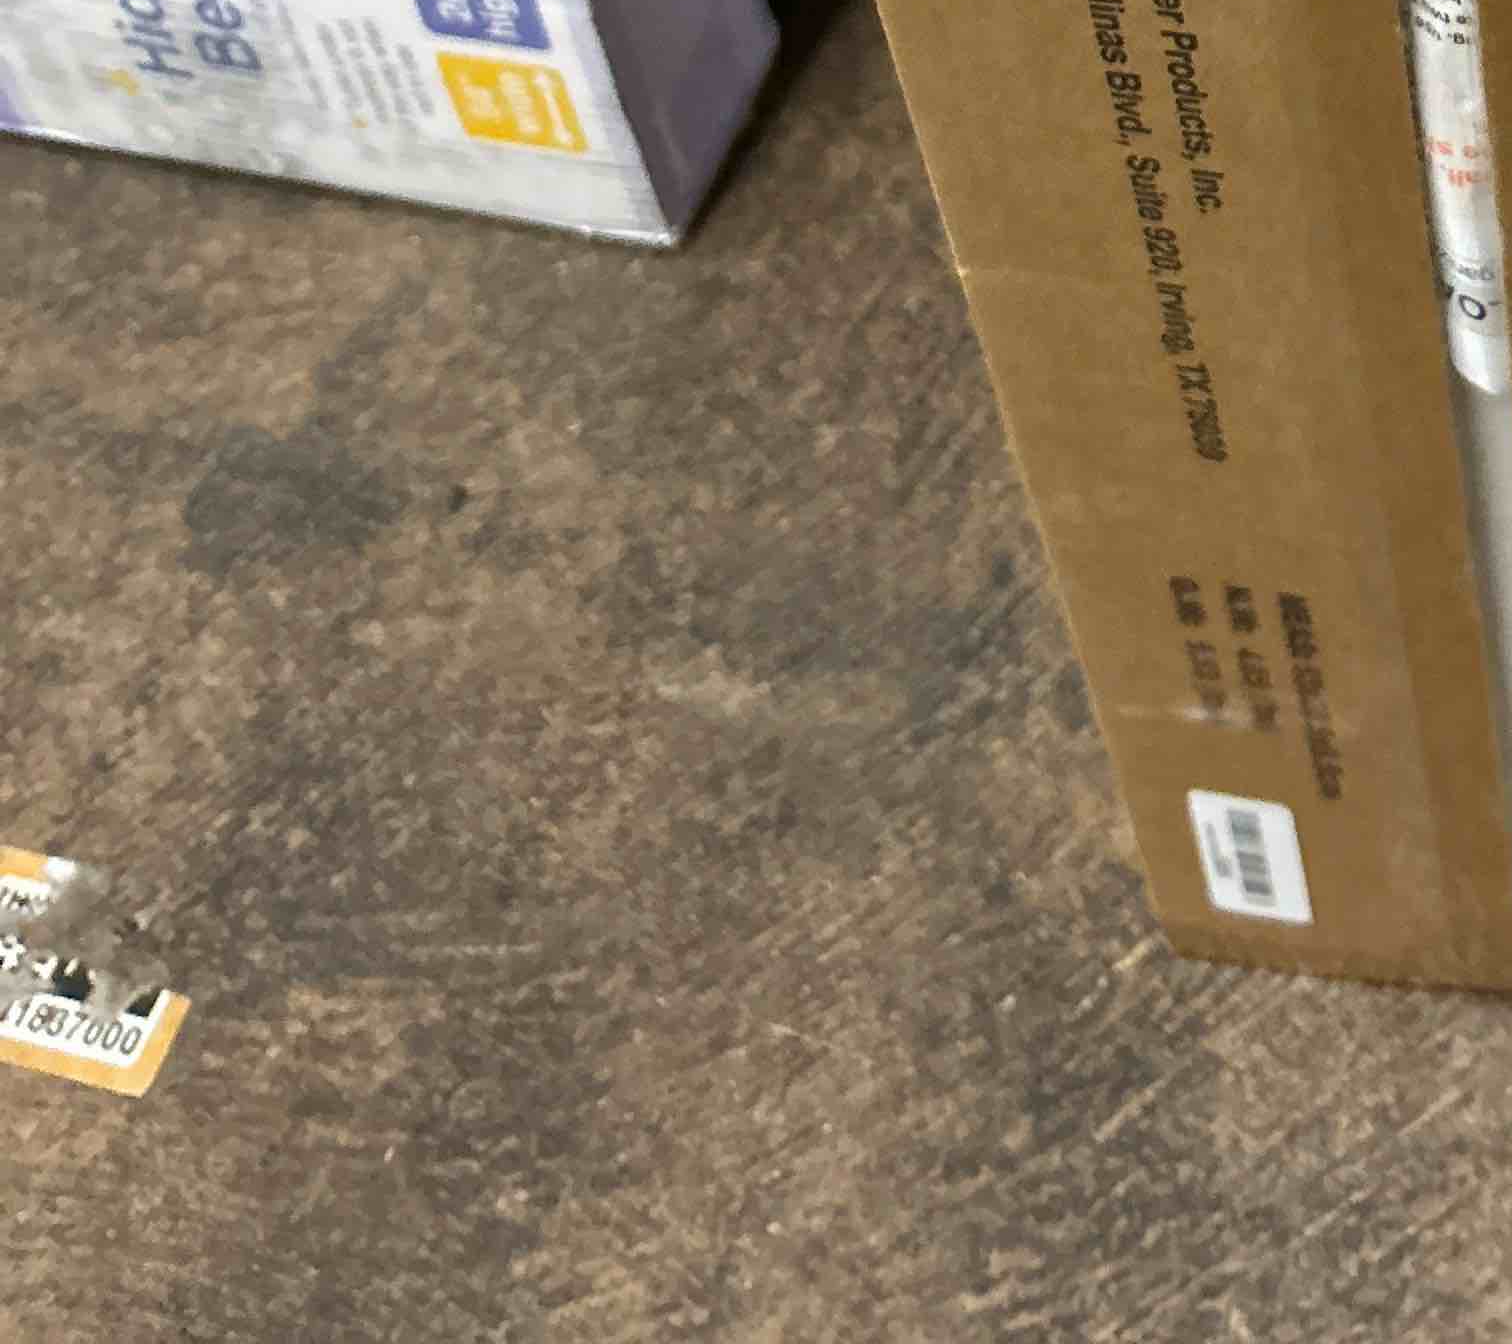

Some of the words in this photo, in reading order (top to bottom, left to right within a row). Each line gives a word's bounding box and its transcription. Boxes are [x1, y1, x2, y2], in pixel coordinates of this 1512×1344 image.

[1160, 29, 1215, 161] Products,
[1191, 168, 1225, 214] Inc.
[1125, 154, 1168, 222] Suite
[1175, 361, 1213, 395] TX
[0, 1000, 142, 1055] 1837000
